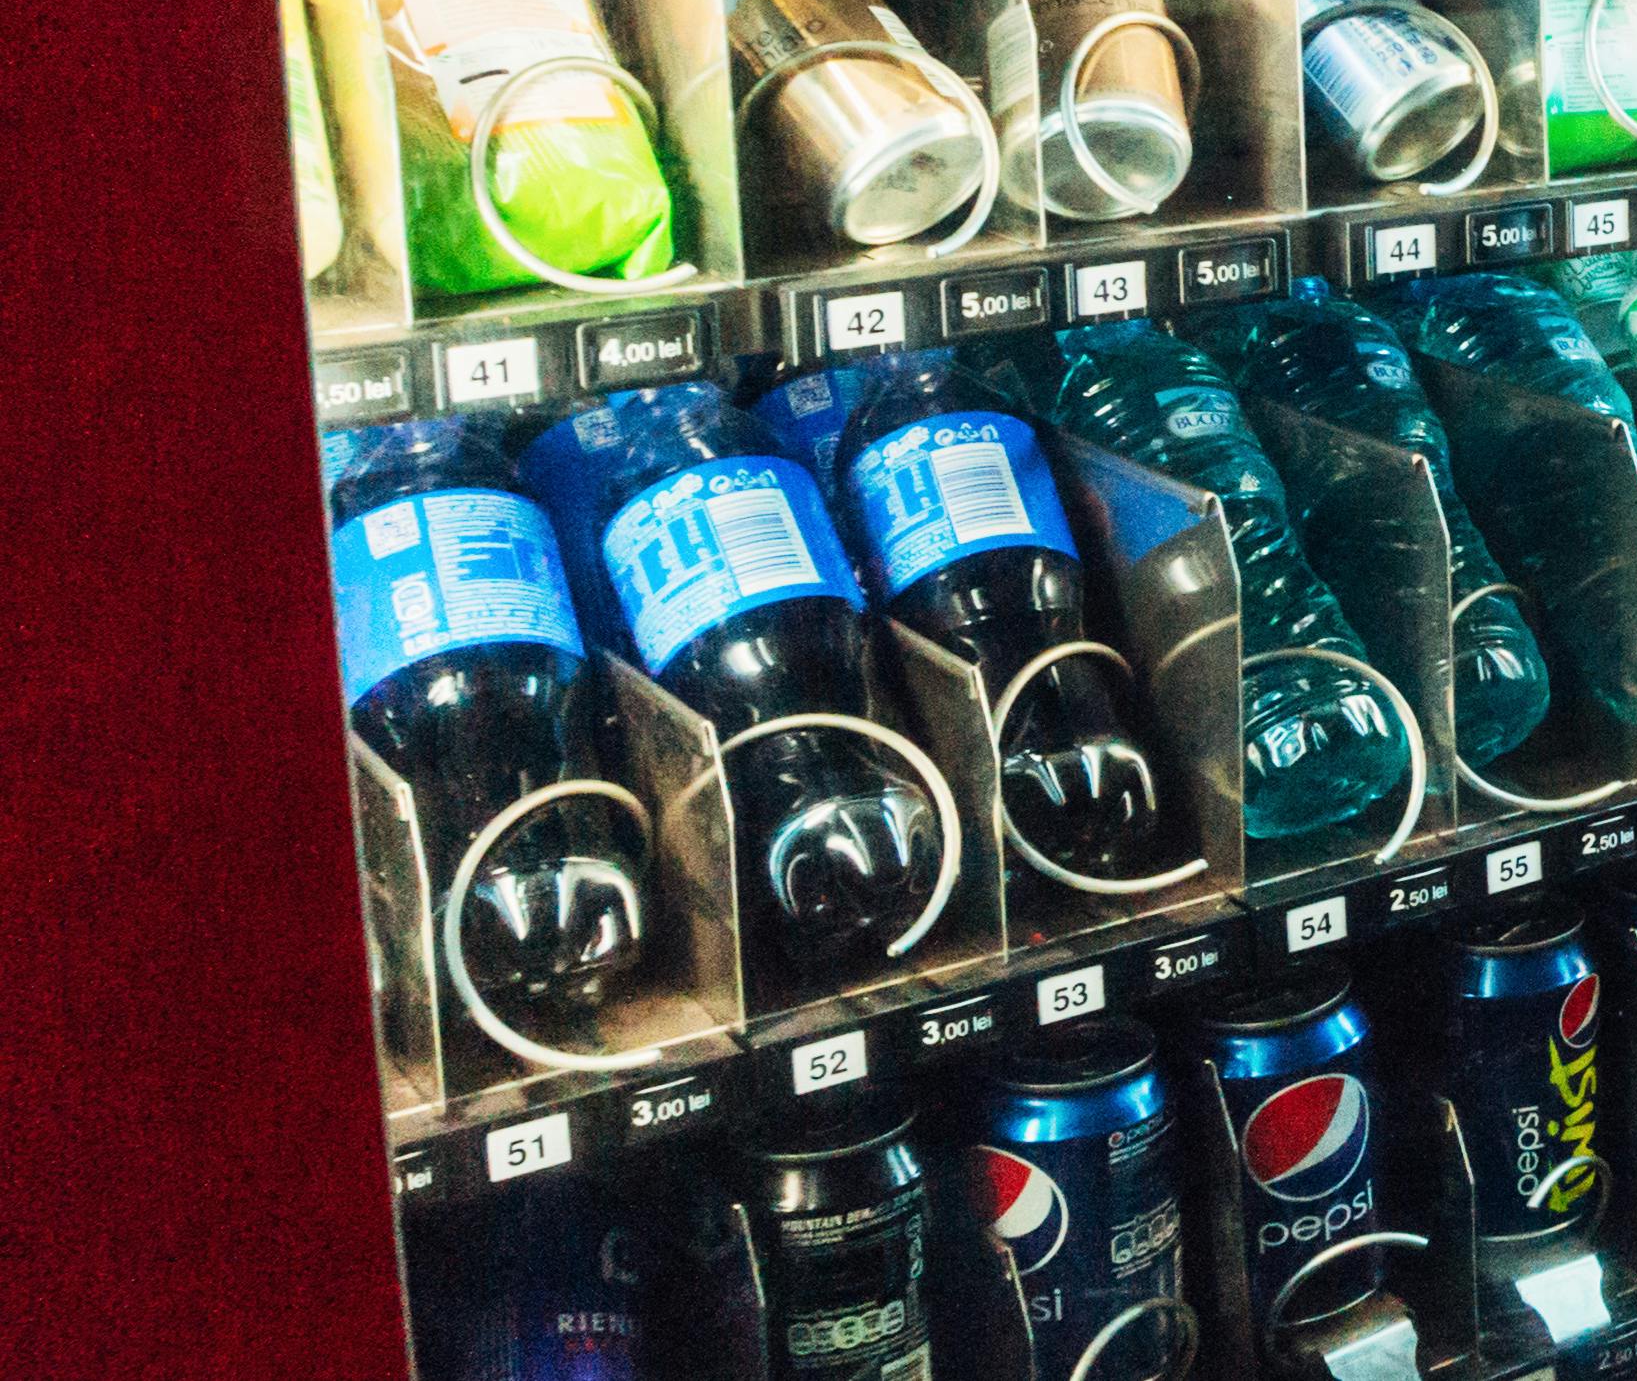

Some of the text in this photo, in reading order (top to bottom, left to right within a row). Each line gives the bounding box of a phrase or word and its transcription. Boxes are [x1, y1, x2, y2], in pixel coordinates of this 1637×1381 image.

[1586, 211, 1617, 237] 45
[1389, 237, 1422, 264] 44
[1093, 276, 1129, 303] 43
[847, 307, 885, 337] 42
[470, 358, 511, 387] 41
[363, 375, 393, 401] lei
[1499, 856, 1530, 882] 55
[1300, 913, 1333, 941] 54
[1053, 981, 1089, 1009] 53
[810, 1050, 849, 1079] 52
[508, 1135, 548, 1166] 51
[1513, 1104, 1541, 1198] pepsi
[407, 1168, 432, 1189] lei
[1258, 1178, 1375, 1254] pepsi
